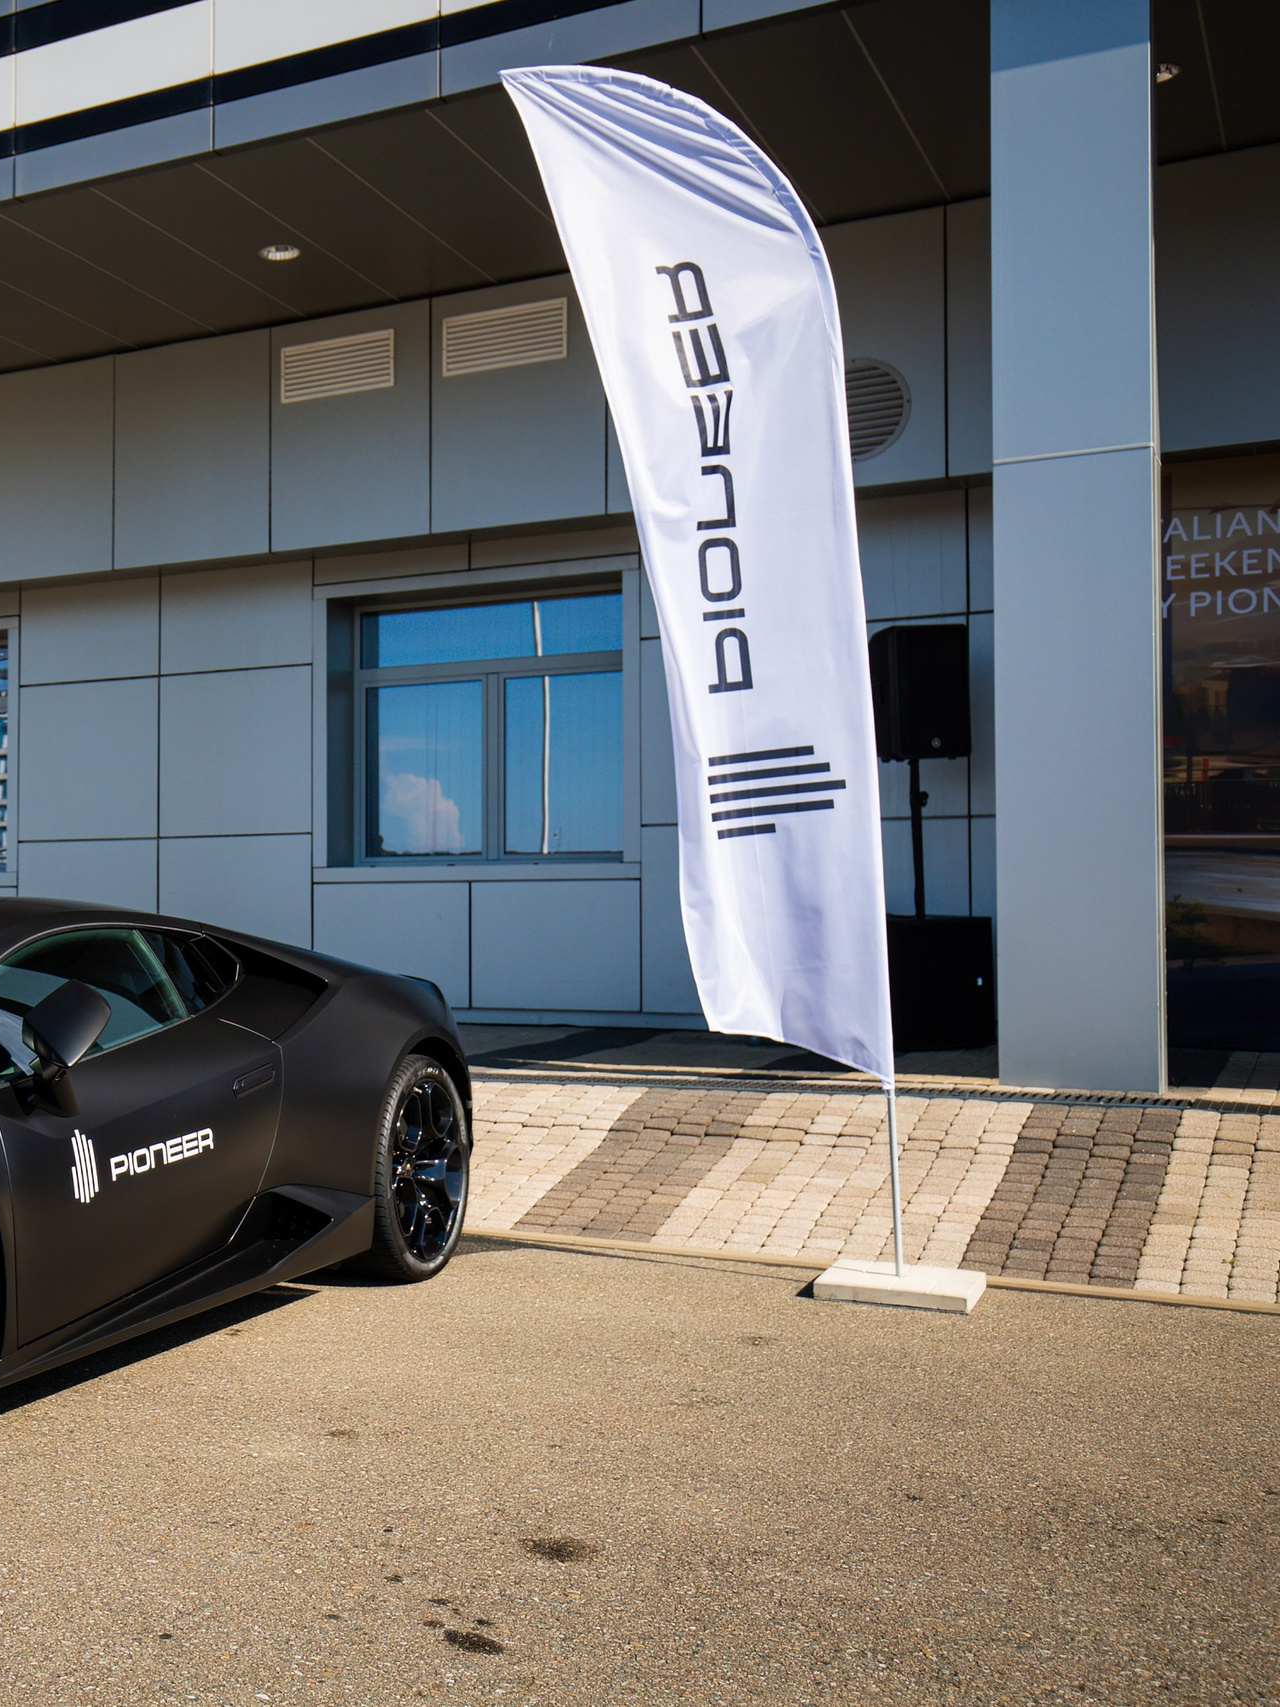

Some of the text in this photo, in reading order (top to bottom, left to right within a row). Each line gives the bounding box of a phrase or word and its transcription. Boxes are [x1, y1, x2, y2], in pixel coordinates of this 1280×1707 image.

[655, 261, 754, 695] PIONEER
[1161, 508, 1280, 543] ALIAN
[109, 1127, 214, 1182] PIONEER
